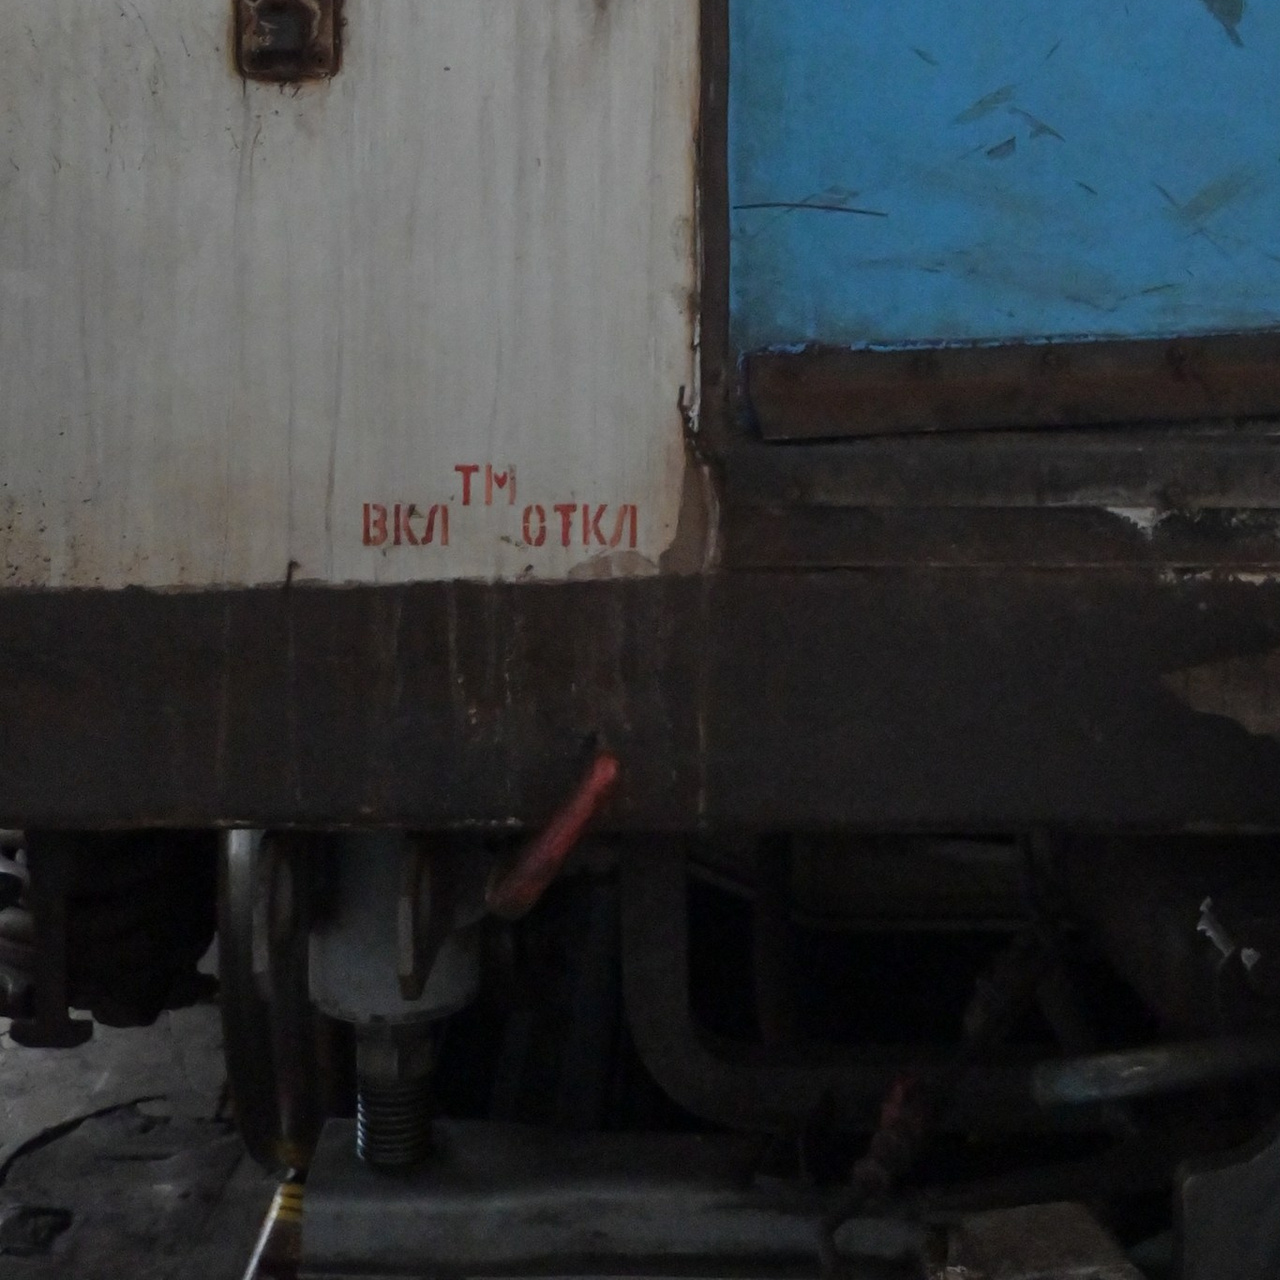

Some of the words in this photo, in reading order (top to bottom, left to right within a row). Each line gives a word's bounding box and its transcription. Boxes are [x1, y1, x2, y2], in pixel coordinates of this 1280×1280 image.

[454, 463, 517, 506] ТМ
[362, 502, 450, 547] ВКЛ
[522, 503, 638, 549] ОТКЛ
